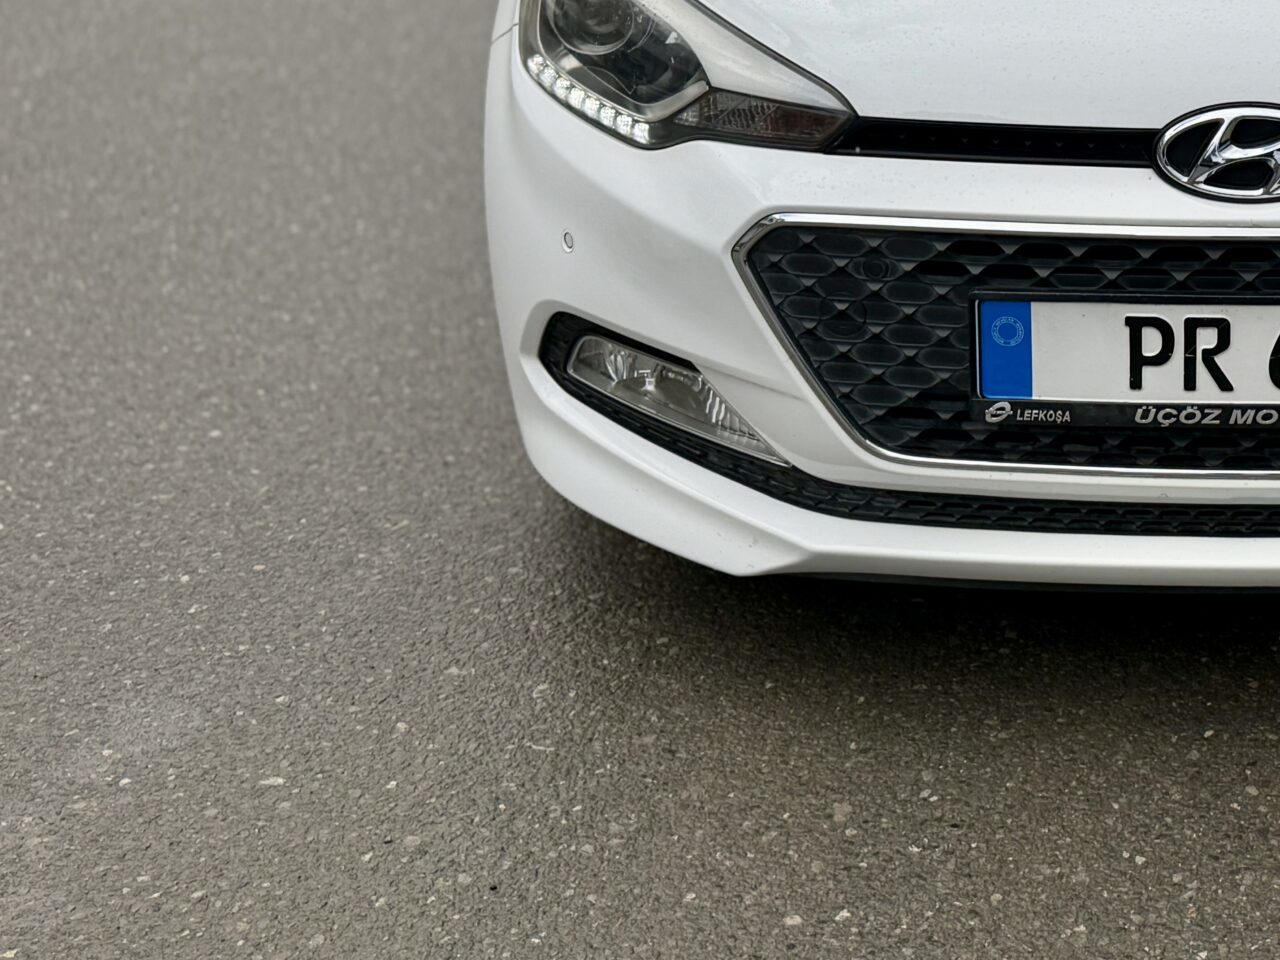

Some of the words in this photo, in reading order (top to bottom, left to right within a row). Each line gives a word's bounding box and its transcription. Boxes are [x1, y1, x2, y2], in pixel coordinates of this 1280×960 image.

[1124, 316, 1234, 391] PR
[1016, 409, 1071, 423] LEFKOŞA
[1134, 405, 1222, 427] ÜÇÖZ
